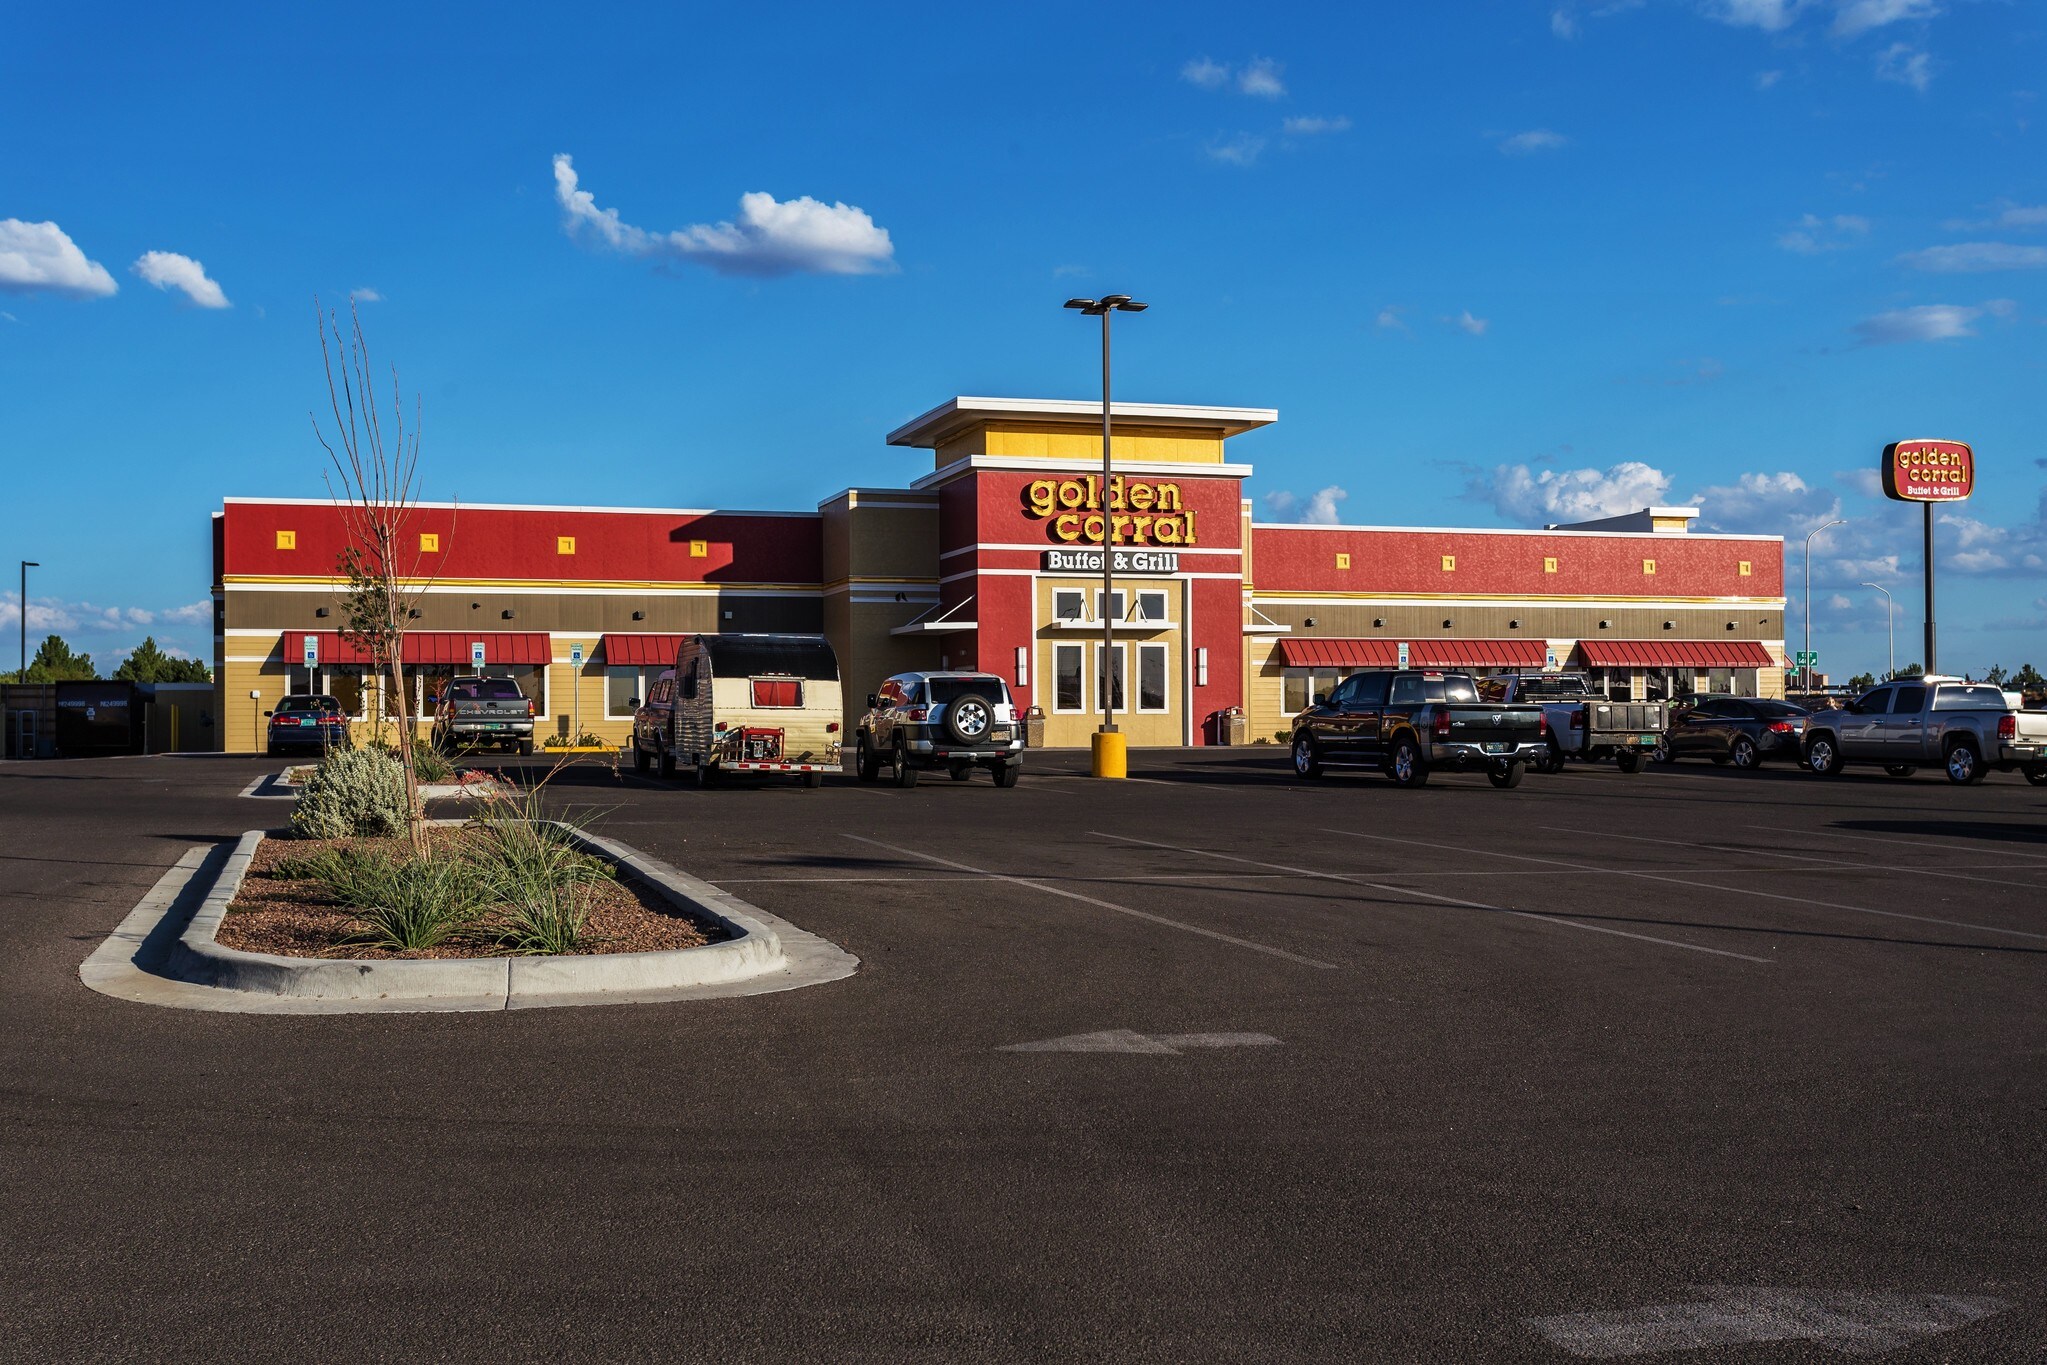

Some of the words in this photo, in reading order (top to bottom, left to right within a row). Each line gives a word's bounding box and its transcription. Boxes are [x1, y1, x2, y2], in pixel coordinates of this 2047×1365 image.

[1899, 447, 1961, 469] golden
[1909, 465, 1967, 483] corral
[1030, 475, 1183, 516] golden
[1907, 485, 1931, 495] Buffet
[1933, 487, 1940, 495] &
[1940, 486, 1960, 496] Grill
[1056, 511, 1198, 544] corral
[1113, 553, 1128, 570] &
[1132, 553, 1179, 571] Grill
